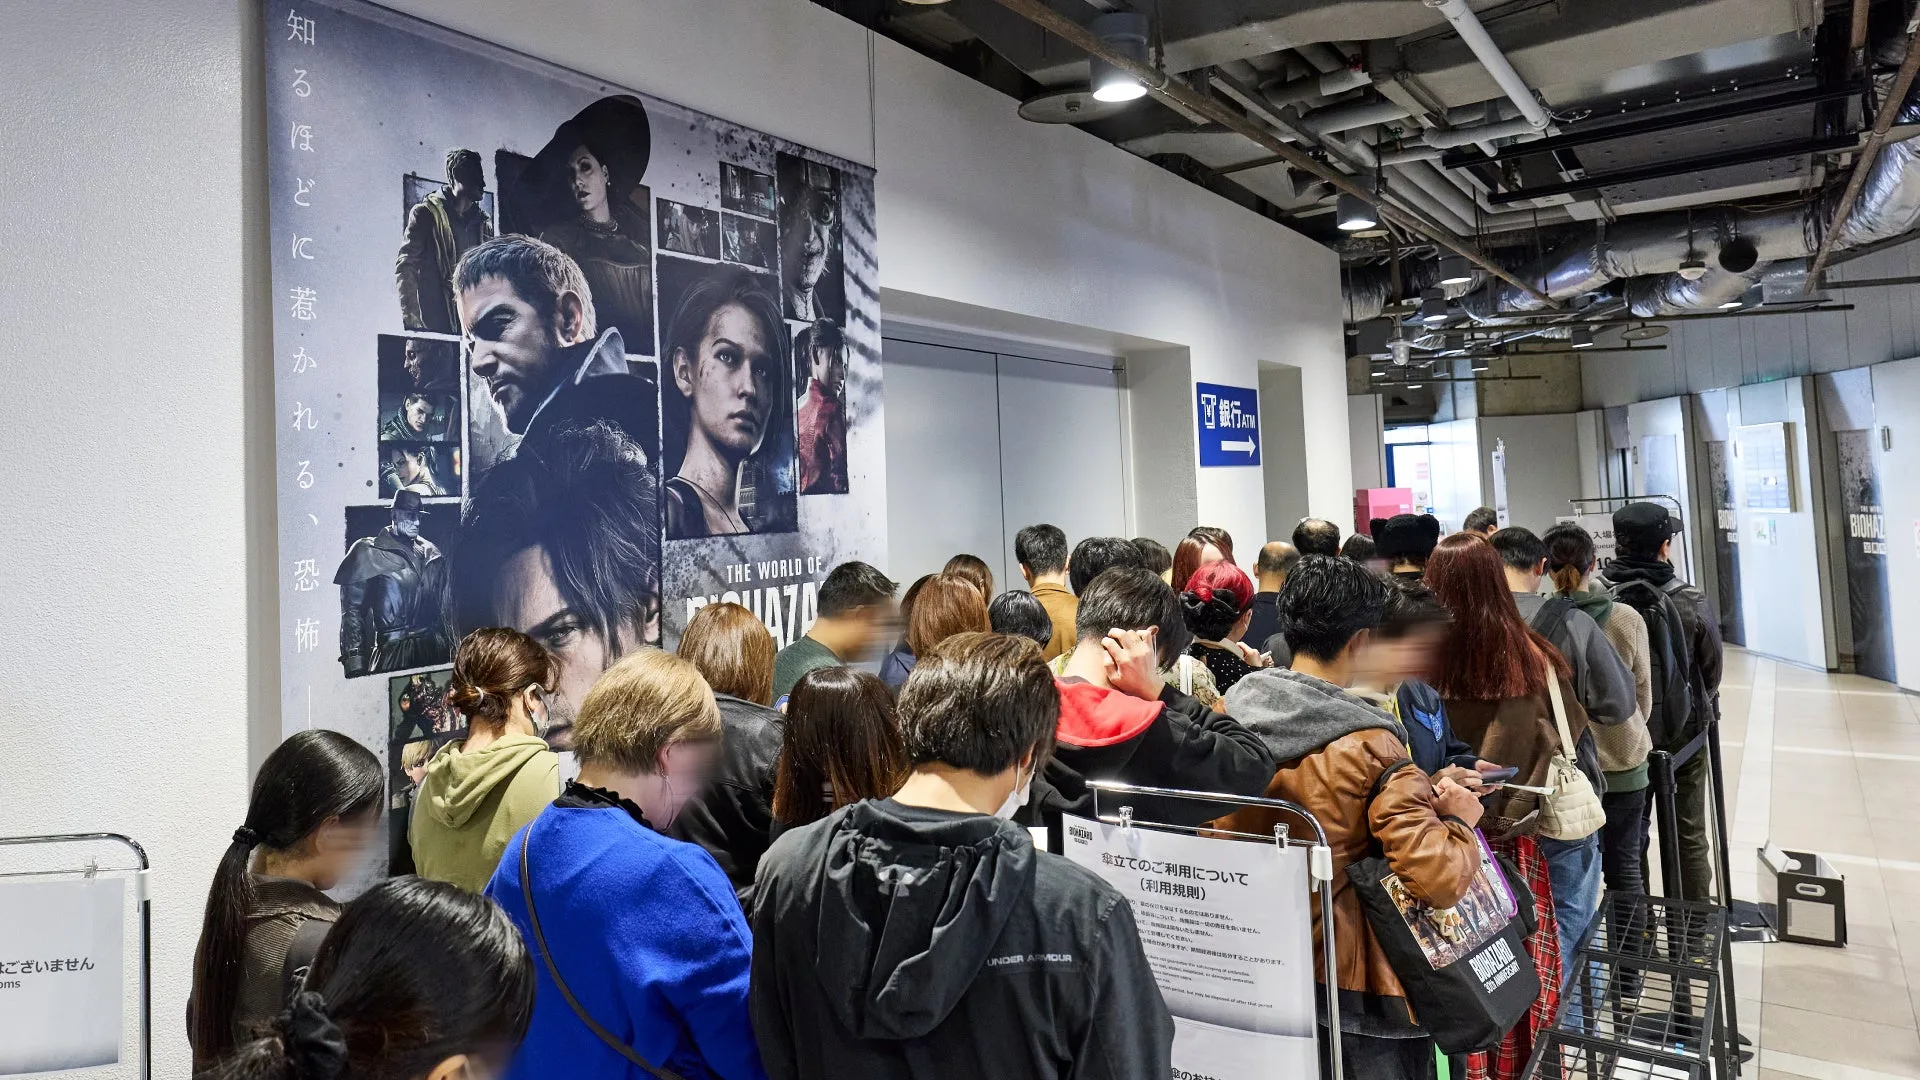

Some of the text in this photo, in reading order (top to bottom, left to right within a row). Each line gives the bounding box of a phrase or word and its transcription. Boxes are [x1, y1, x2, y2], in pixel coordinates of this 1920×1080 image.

[727, 556, 822, 583] THE WORLD OF
[1101, 852, 1249, 886] 傘立てのご利用について
[987, 954, 1072, 966] UNDER ARMOUR
[1468, 937, 1516, 983] BIOHAZARD
